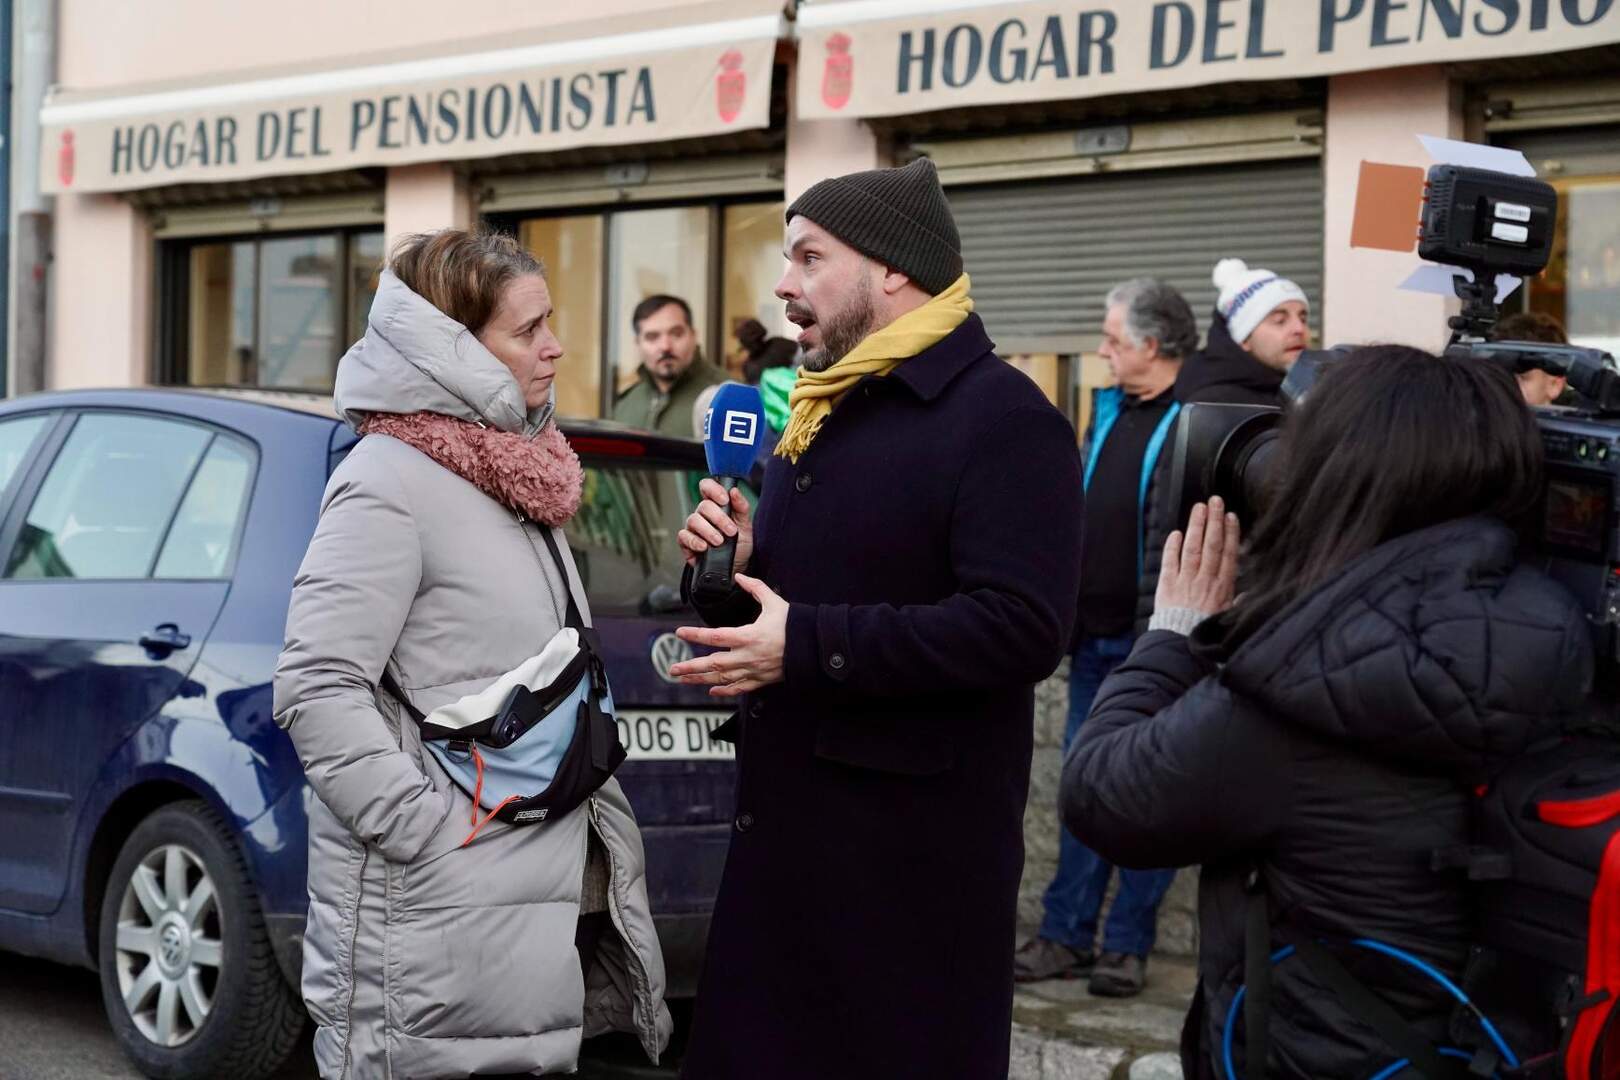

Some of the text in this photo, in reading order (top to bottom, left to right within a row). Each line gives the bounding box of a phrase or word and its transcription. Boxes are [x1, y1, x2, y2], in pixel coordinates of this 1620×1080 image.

[896, 10, 1118, 93] HOGAR
[1149, 0, 1285, 70] DEL
[111, 67, 656, 174] HOGAR DEL PENSIONISTA
[685, 717, 731, 752] DM
